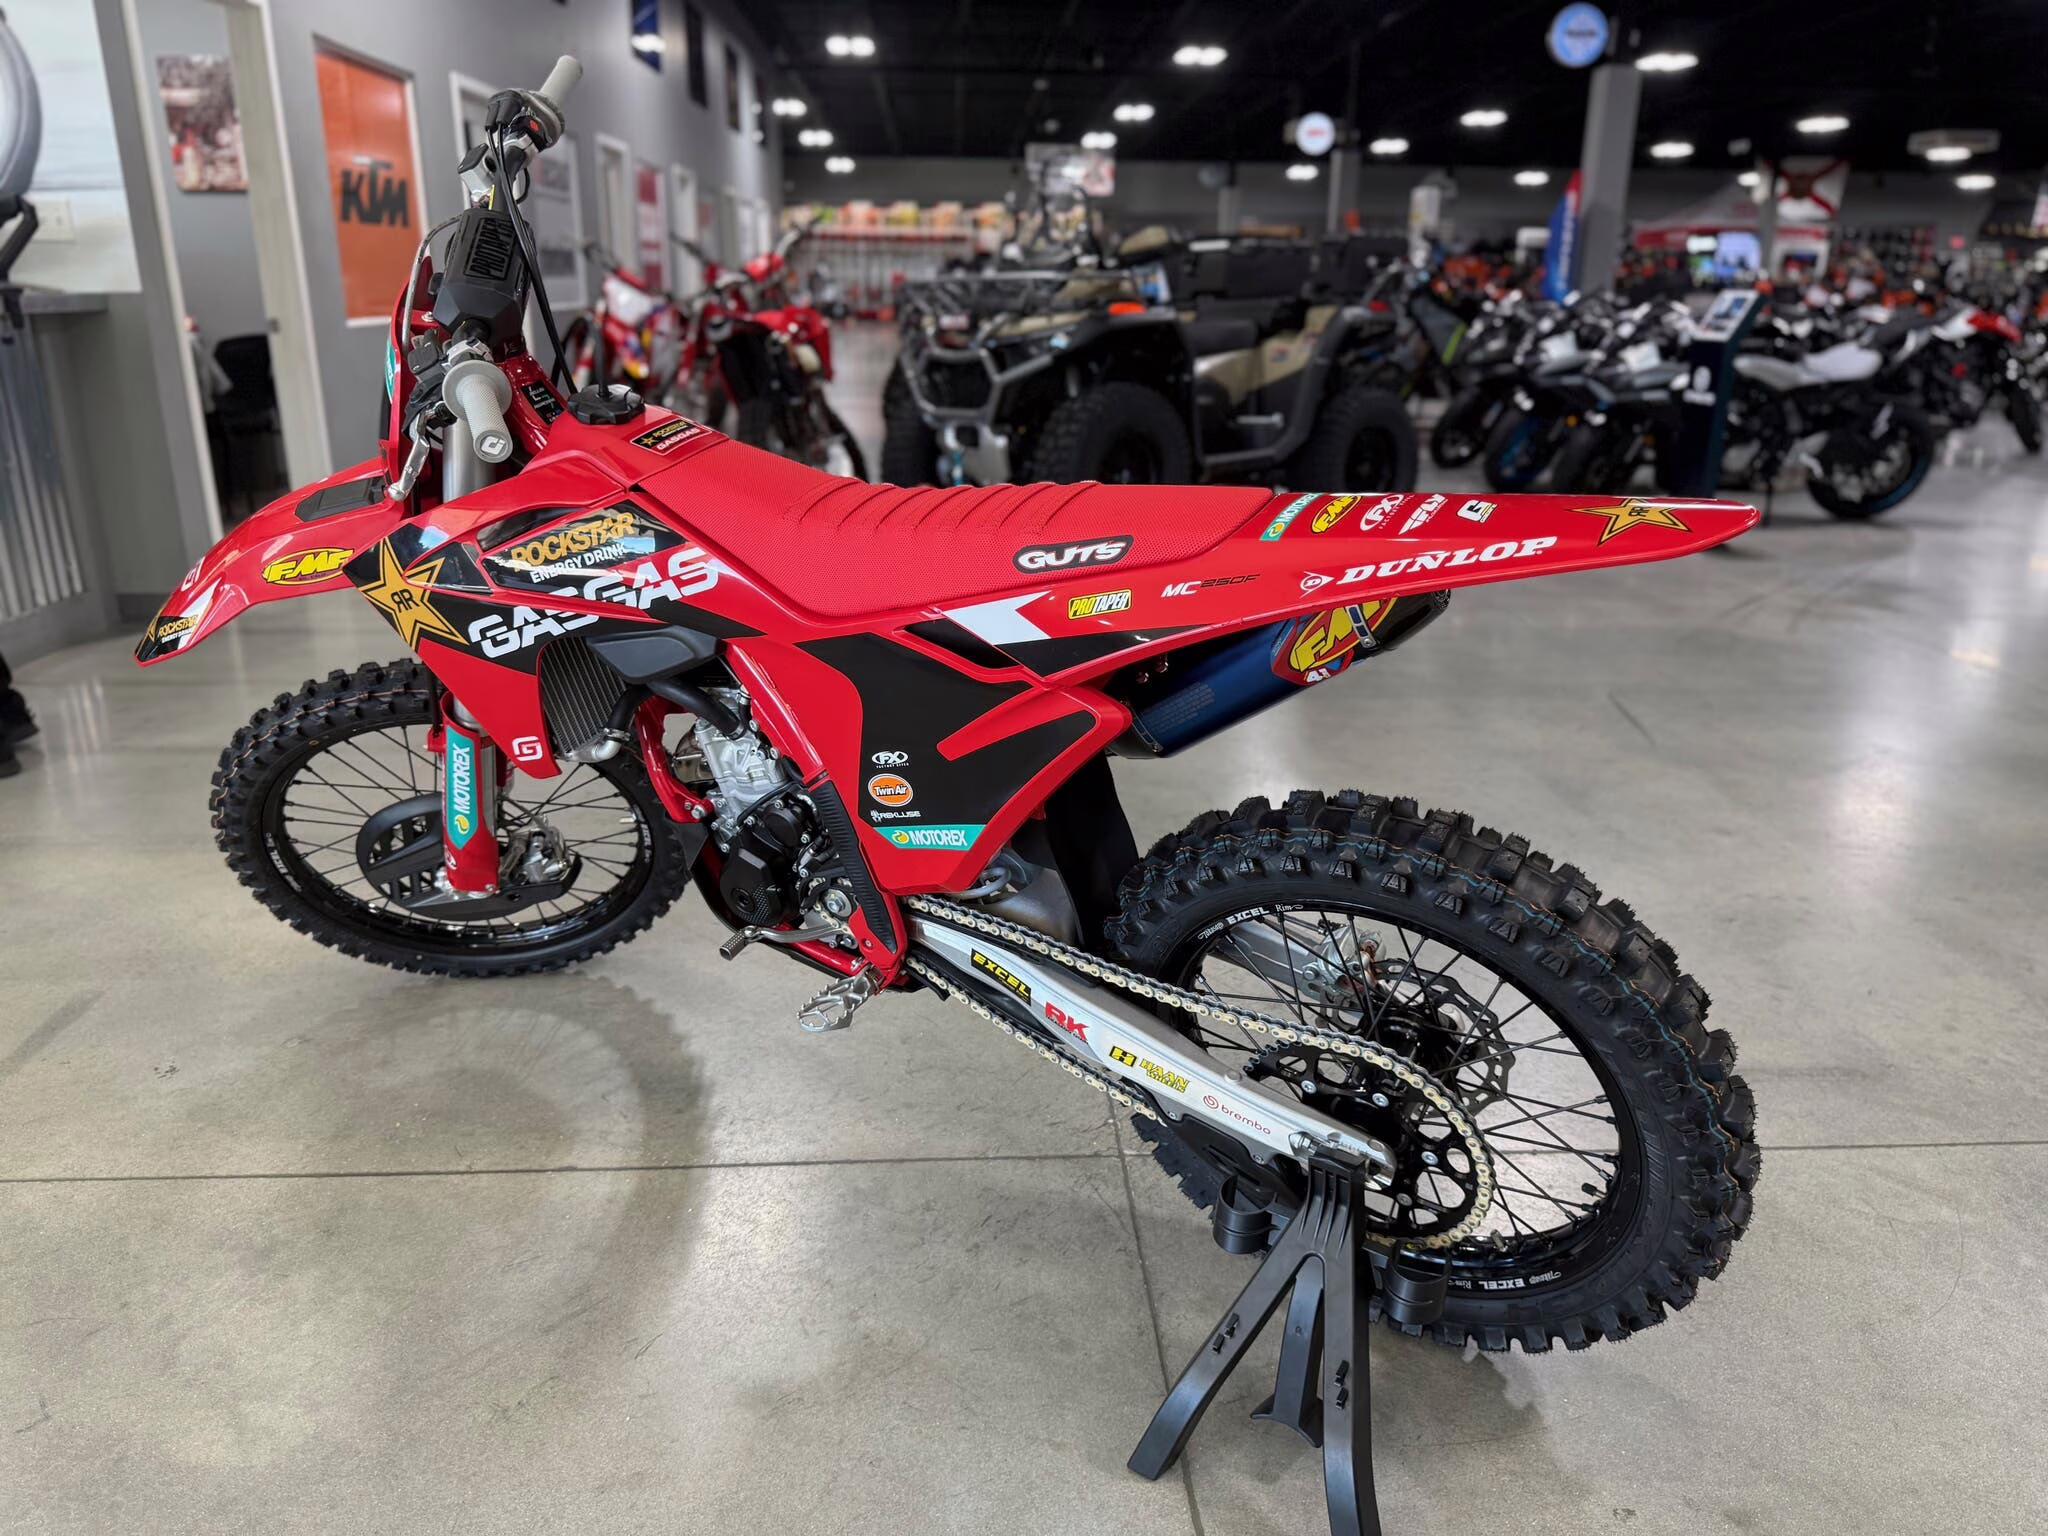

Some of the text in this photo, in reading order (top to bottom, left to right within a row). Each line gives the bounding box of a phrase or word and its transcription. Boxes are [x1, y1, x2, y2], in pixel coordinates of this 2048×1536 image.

[341, 160, 410, 228] KTM
[1313, 496, 1361, 532] FMF
[512, 512, 634, 573] ROCKSTAR
[1017, 541, 1127, 570] GUTS
[265, 550, 354, 582] FMF
[531, 541, 628, 584] ENERGY DRINK
[1336, 536, 1557, 584] DUNLOP
[467, 547, 719, 659] GASGAS
[1070, 591, 1130, 617] PROTAPER
[158, 615, 199, 639] ROCKSTAR
[452, 743, 471, 815] MOTOREX
[875, 784, 908, 797] Twin Air
[909, 830, 968, 846] MOTOREX
[1226, 907, 1269, 926] EXCEL
[1275, 904, 1294, 913] Rim
[972, 953, 1031, 996] EXCEL
[1045, 1002, 1088, 1041] RK
[1140, 1058, 1190, 1088] HAAN
[1220, 1103, 1272, 1135] brembo
[1478, 1279, 1526, 1290] EXCEL
